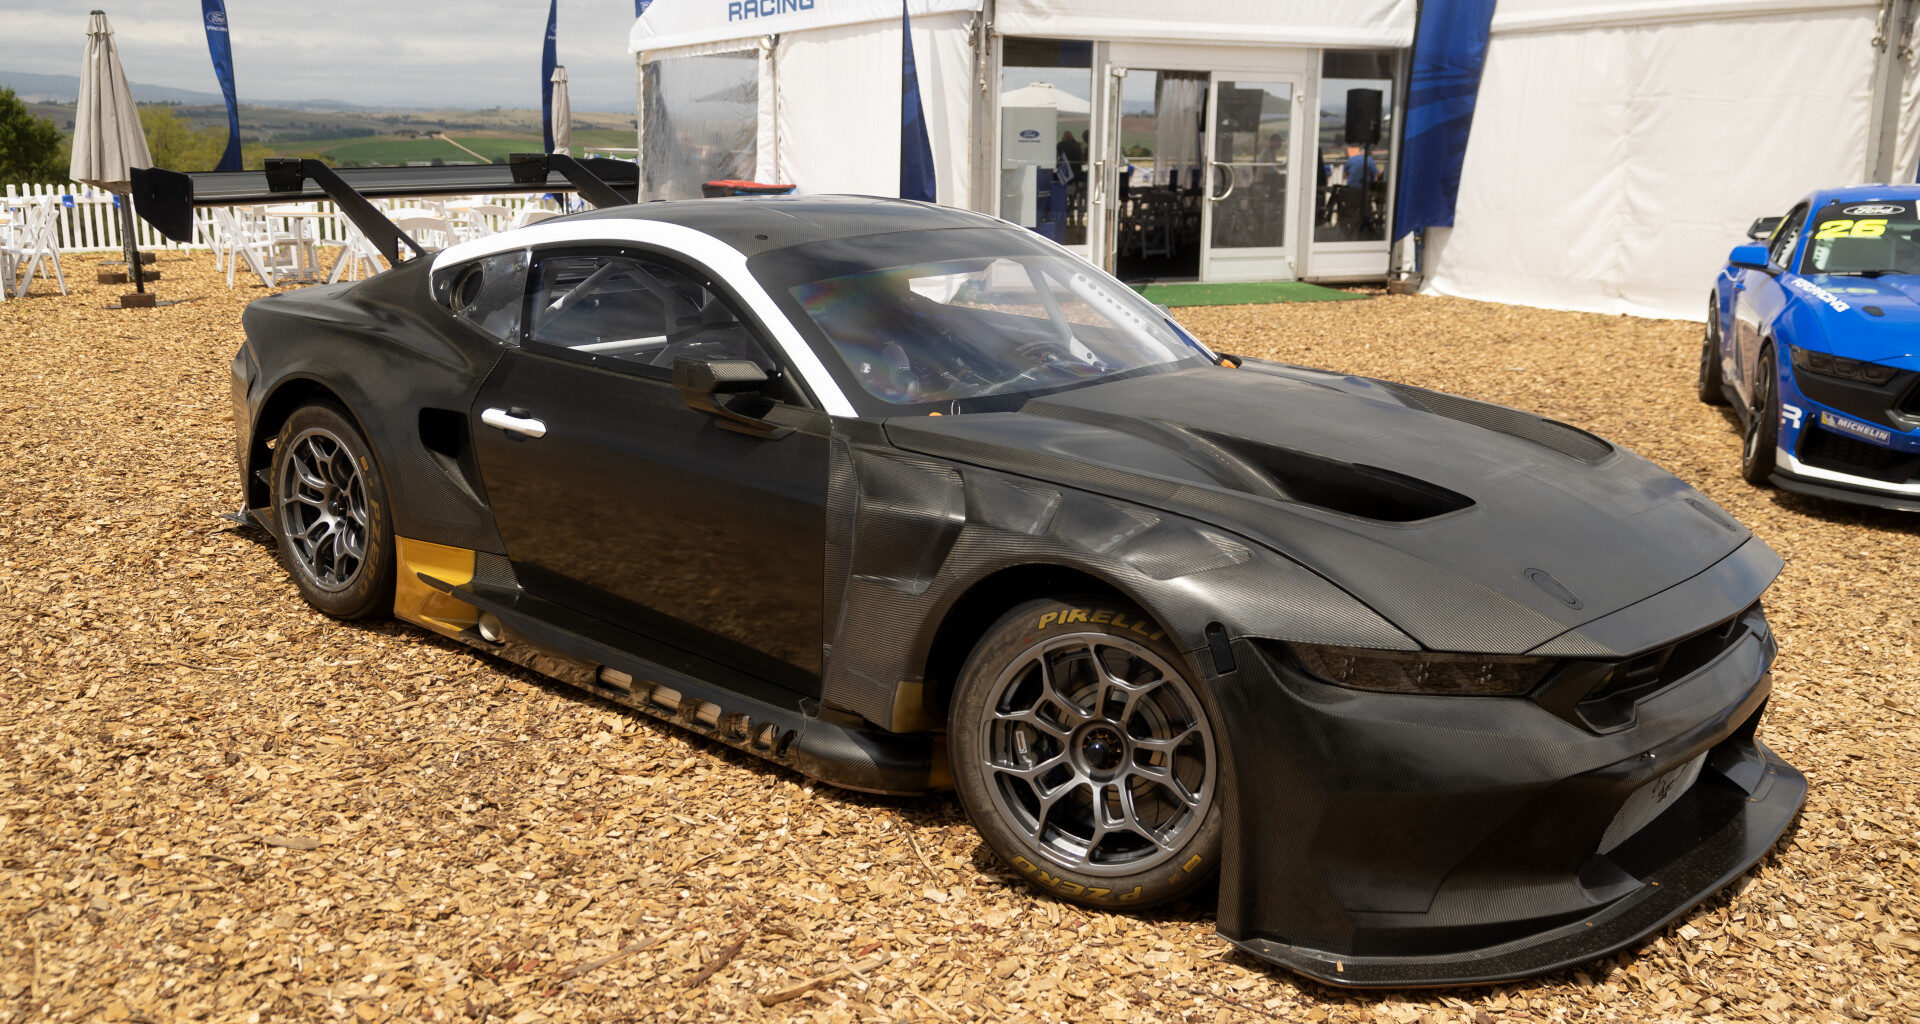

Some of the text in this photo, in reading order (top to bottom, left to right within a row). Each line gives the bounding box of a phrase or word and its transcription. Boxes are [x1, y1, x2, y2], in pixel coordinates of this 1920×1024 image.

[1815, 219, 1888, 239] 26
[1837, 418, 1888, 441] MICHELIN
[1037, 608, 1166, 641] PIRELLI
